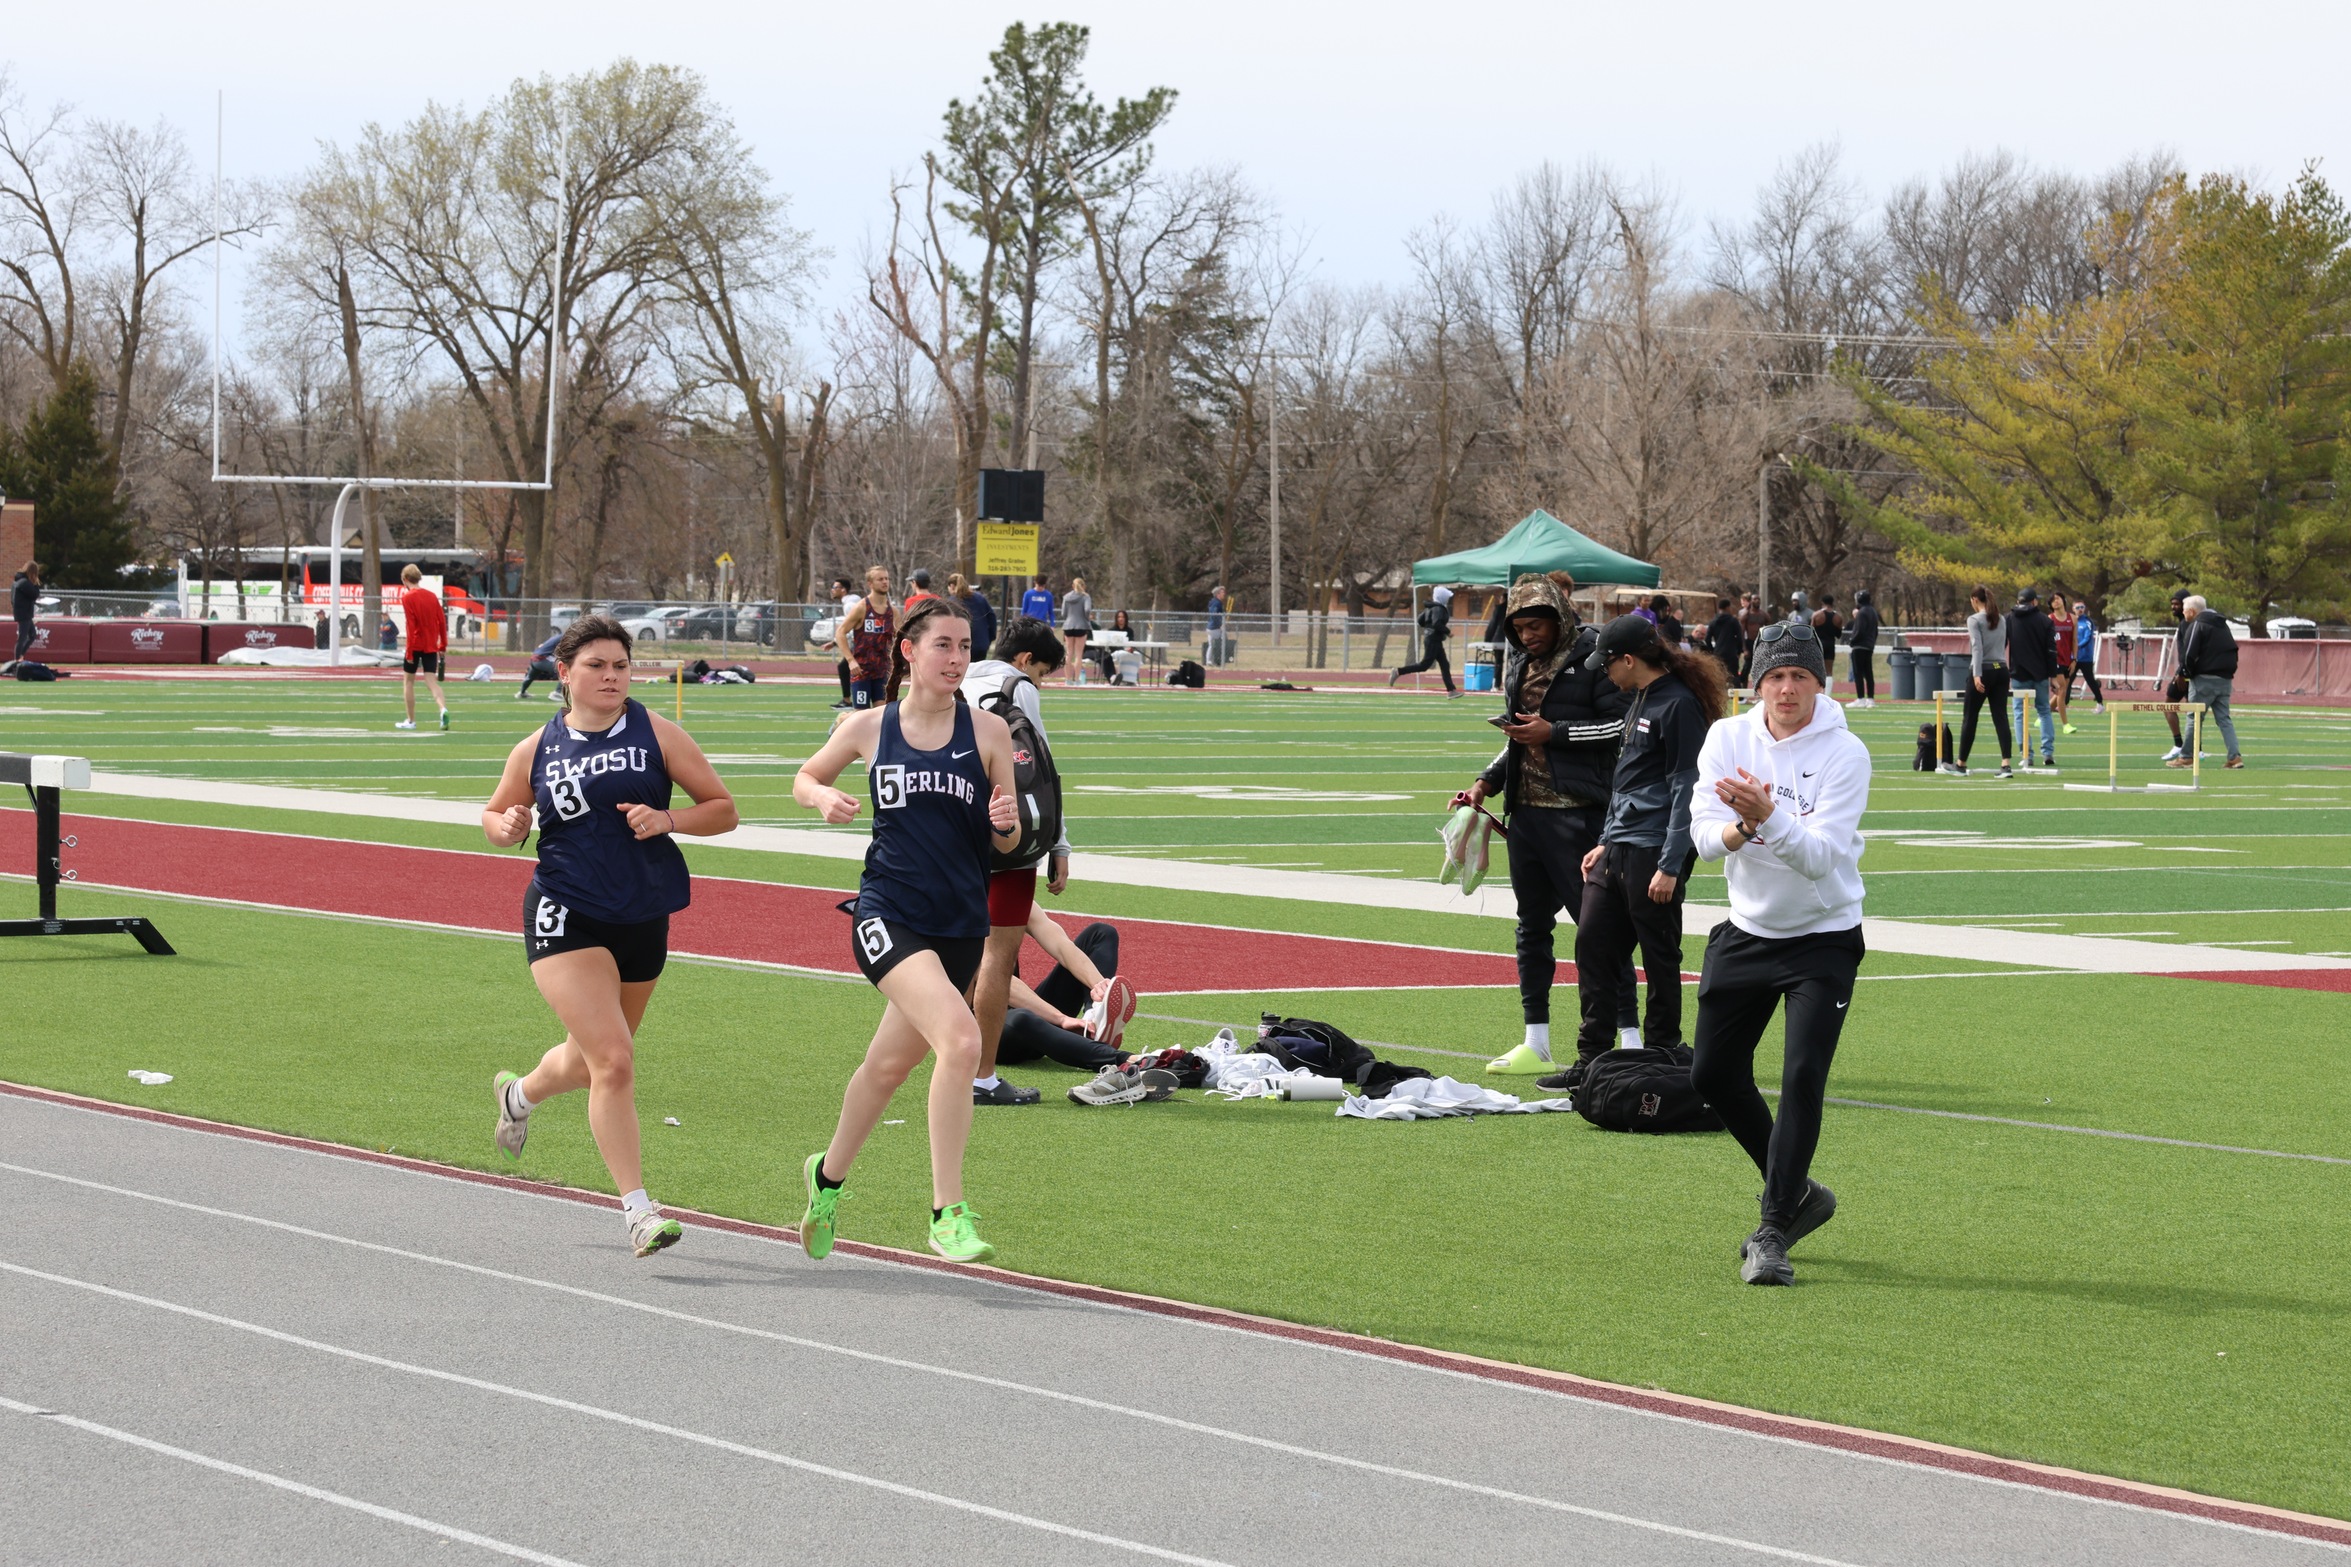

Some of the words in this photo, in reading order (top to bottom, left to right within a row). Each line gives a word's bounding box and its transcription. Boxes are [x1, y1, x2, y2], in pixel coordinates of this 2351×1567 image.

[131, 628, 164, 641] Richey
[245, 630, 276, 643] Richey
[866, 620, 873, 631] 3
[858, 692, 865, 703] 3
[545, 747, 648, 788] SWOSU
[555, 780, 582, 816] 3
[880, 768, 900, 805] 5
[905, 771, 975, 805] ERLING
[538, 901, 562, 934] 3
[861, 920, 886, 957] 5
